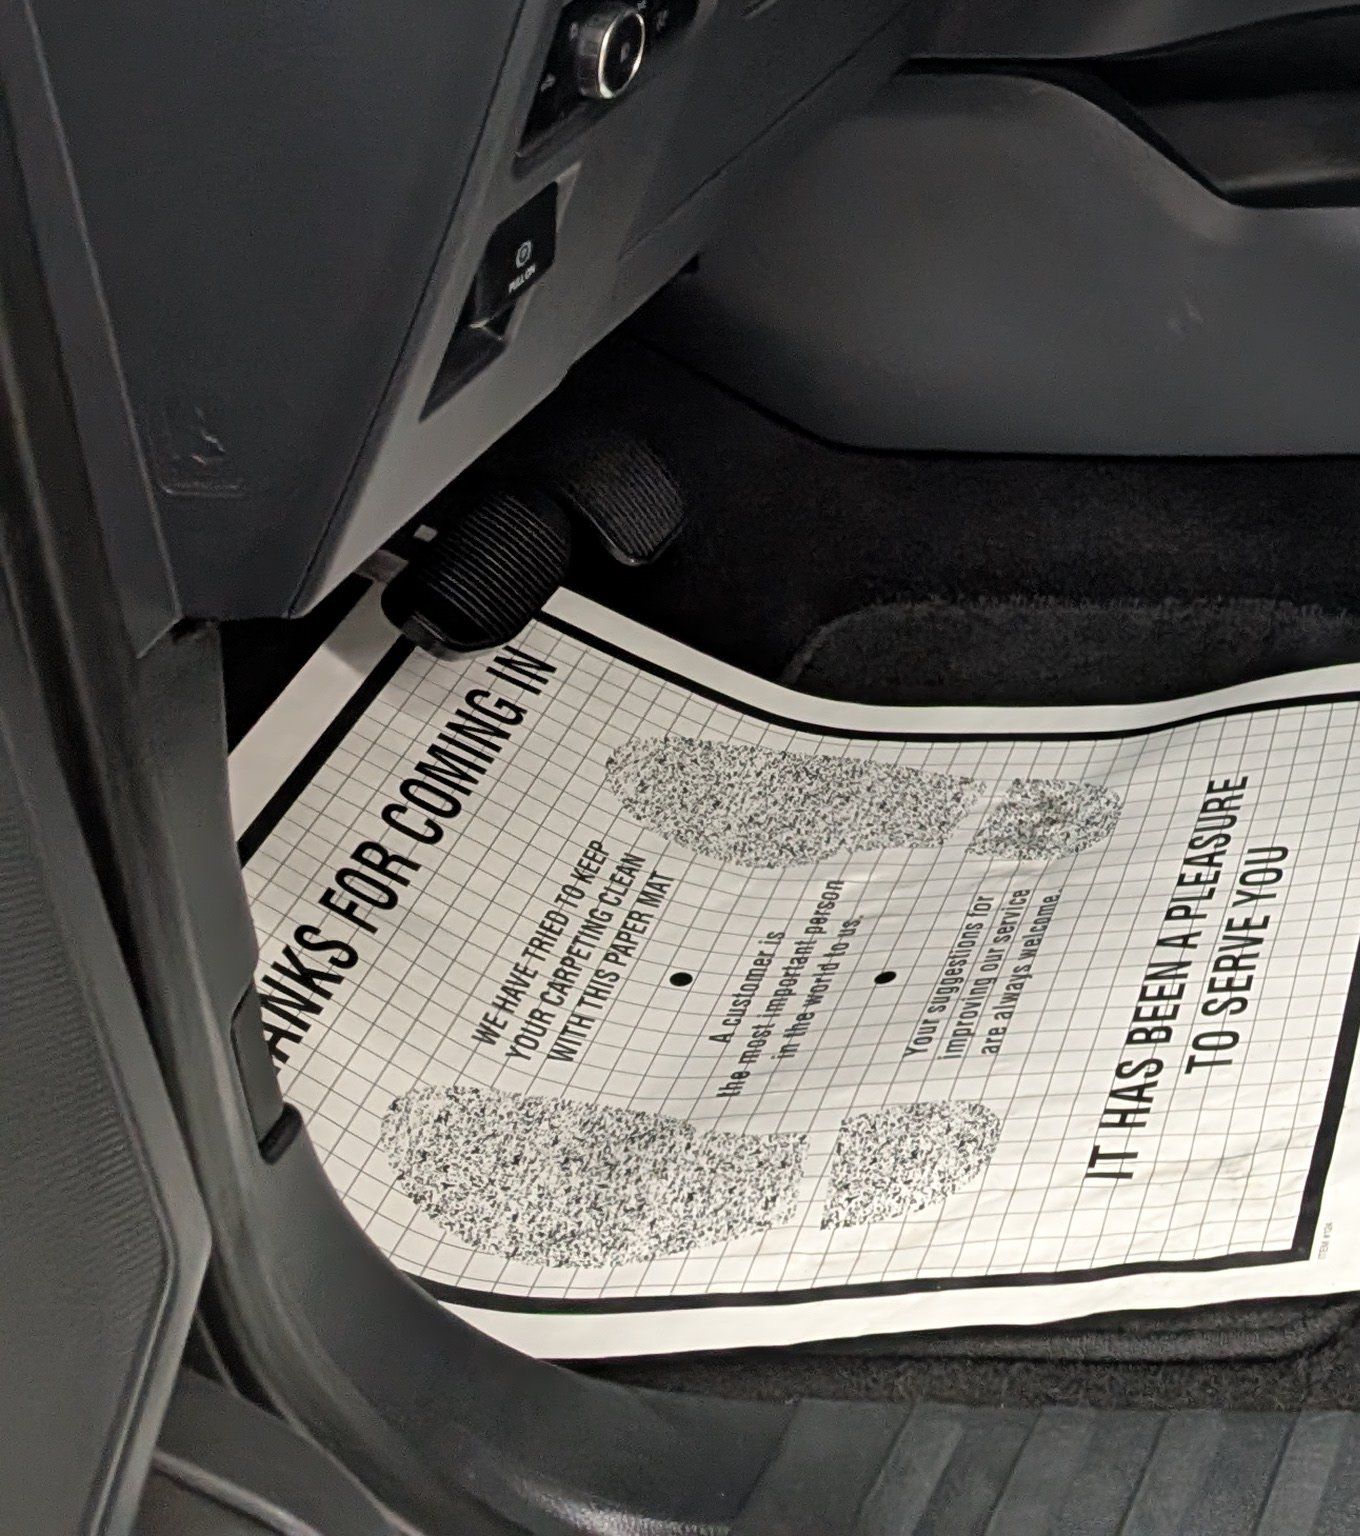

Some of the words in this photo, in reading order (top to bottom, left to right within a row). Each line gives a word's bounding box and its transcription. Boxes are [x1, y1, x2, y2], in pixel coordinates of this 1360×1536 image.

[524, 264, 536, 280] ON
[260, 924, 359, 1068] ANKS
[318, 840, 421, 935] FOR
[381, 689, 528, 845] COMING
[486, 645, 558, 695] IN
[1164, 775, 1249, 923] PLEASURE
[1232, 845, 1290, 908] YOU
[471, 1013, 508, 1046] WE
[491, 962, 539, 1015] HAVE
[521, 910, 570, 962] TRIED
[554, 883, 586, 908] TO
[570, 839, 610, 885] KEEP
[505, 1008, 556, 1061] YOUR
[539, 907, 614, 1007] CARPETING
[598, 852, 647, 907] CLEAN
[823, 941, 850, 959] to
[837, 914, 865, 939] us.
[1018, 889, 1064, 961] welcome.
[1156, 930, 1202, 950] A
[547, 1013, 596, 1062] WITH
[577, 968, 621, 1010] THIS
[603, 909, 654, 967] PAPER
[636, 870, 675, 908] MAT
[708, 1032, 735, 1044] A
[722, 950, 776, 1026] customer
[758, 930, 785, 946] is
[716, 1069, 751, 1098] the
[738, 1021, 775, 1065] most
[757, 940, 818, 1018] important
[804, 879, 845, 937] person
[802, 962, 840, 1008] world
[903, 1017, 940, 1058] Your
[927, 922, 984, 1014] suggestions
[966, 895, 994, 917] for
[937, 976, 998, 1061] improving
[980, 947, 1005, 972] our
[993, 889, 1031, 944] service
[992, 963, 1032, 1020] always
[1201, 914, 1270, 1017] SERVE
[783, 1011, 815, 1038] the
[1125, 959, 1193, 1047] BEEN
[771, 1040, 801, 1060] in
[981, 1026, 1005, 1056] are
[1185, 1029, 1240, 1074] TO
[1100, 1056, 1164, 1129] HAS
[1085, 1145, 1139, 1180] IT
